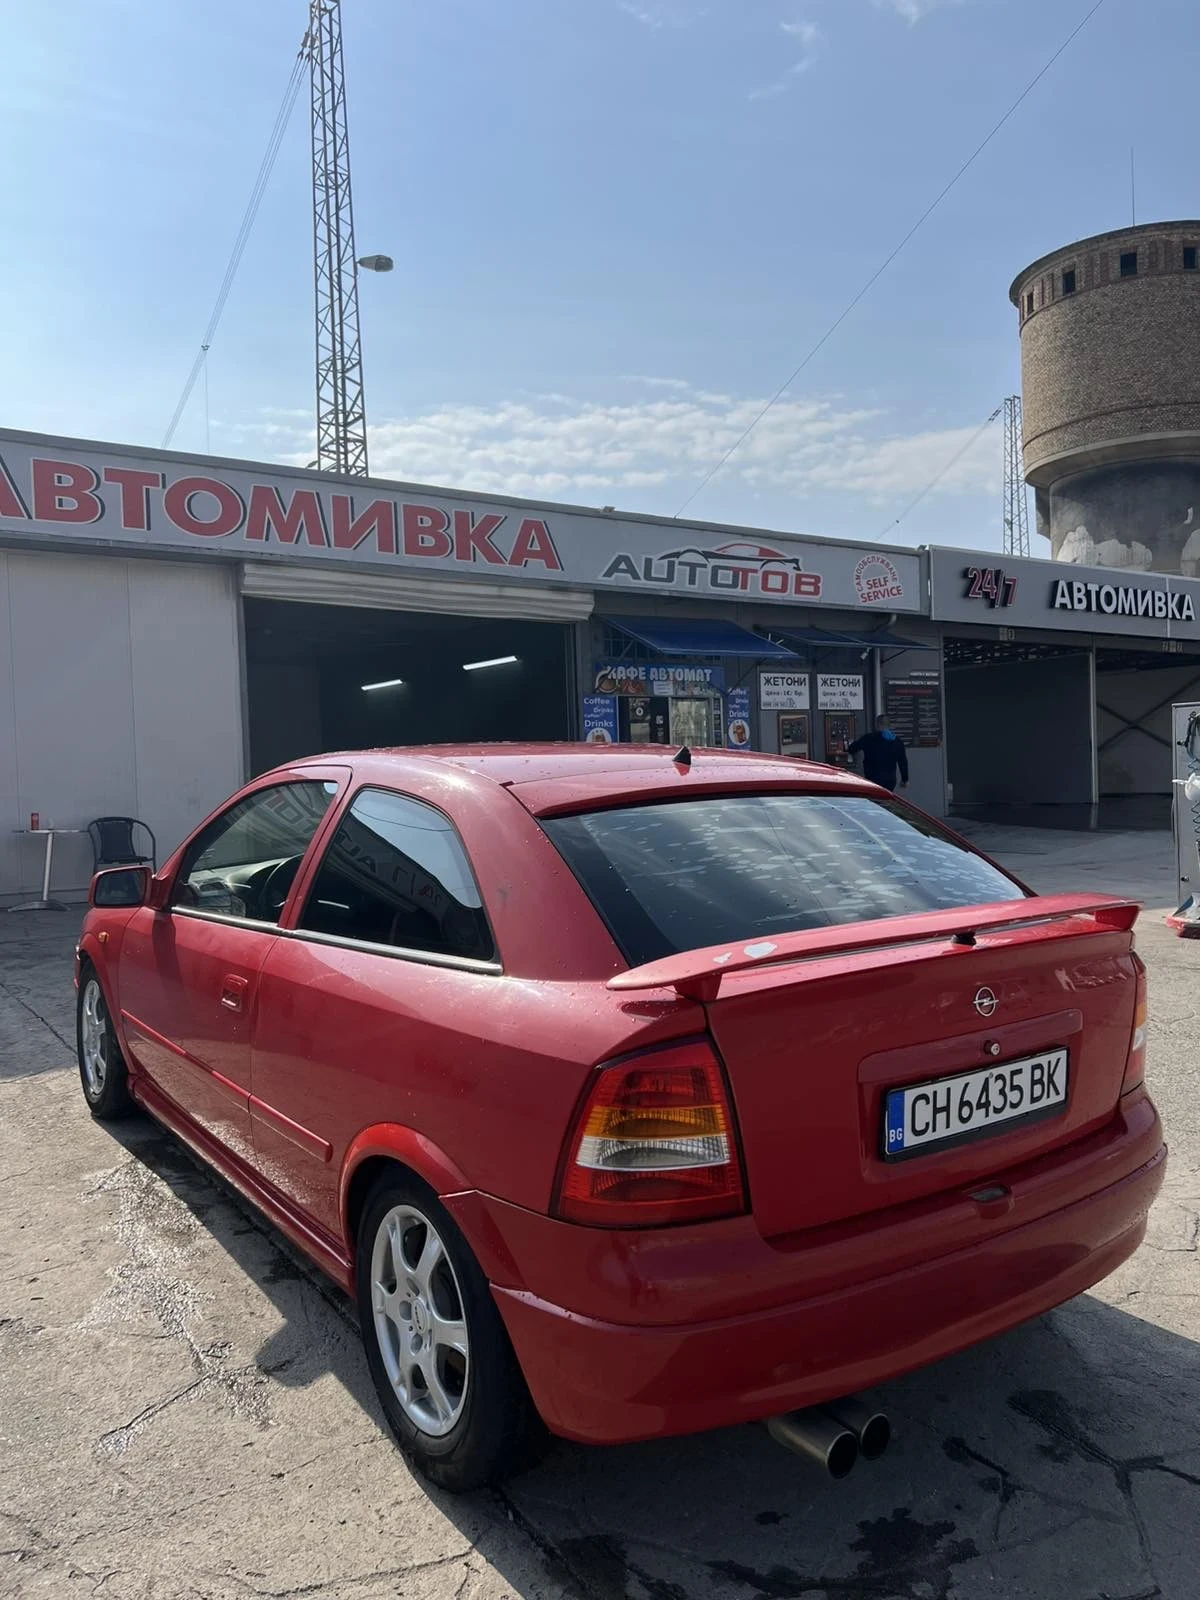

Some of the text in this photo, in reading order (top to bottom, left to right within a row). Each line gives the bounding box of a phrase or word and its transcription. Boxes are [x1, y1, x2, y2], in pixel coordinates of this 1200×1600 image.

[866, 576, 889, 590] SELF
[968, 567, 1018, 609] 24/7
[860, 585, 903, 603] SERVICE
[1053, 579, 1196, 621] АВТОМИВКА
[649, 667, 712, 682] АВТОМАТ
[763, 676, 807, 687] ЖЕТОНИ
[820, 677, 861, 688] ЖЕТОНИ
[583, 697, 610, 705] Coffee
[584, 719, 613, 728] Drinks
[889, 1127, 903, 1143] BG
